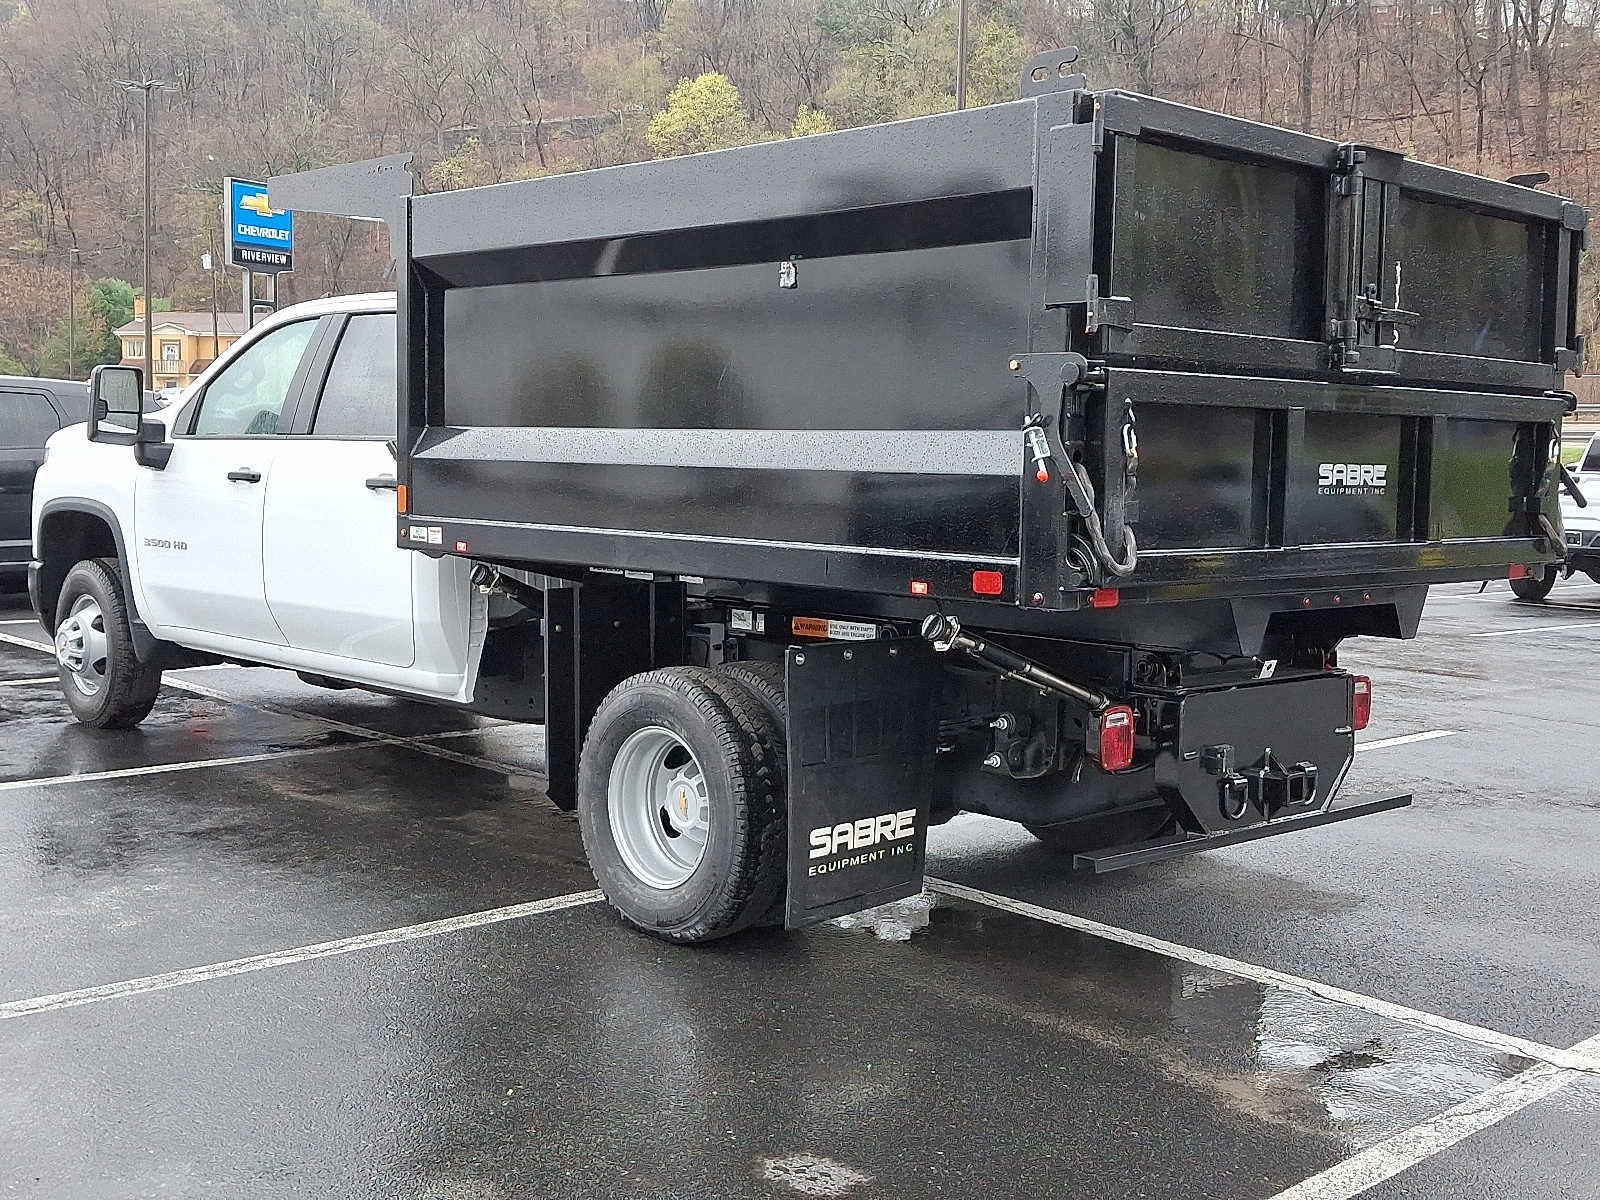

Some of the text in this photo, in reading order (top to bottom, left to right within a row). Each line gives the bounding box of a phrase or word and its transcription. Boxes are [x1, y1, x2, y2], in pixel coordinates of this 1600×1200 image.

[237, 223, 290, 241] CHEVROLET
[241, 249, 287, 265] RIVERVIEW
[1318, 463, 1388, 486] SABRE
[1318, 487, 1386, 495] EQUIPMENT INC
[173, 540, 188, 551] HD
[809, 808, 917, 859] SABRE
[808, 843, 913, 877] EQUIPMENT INC
